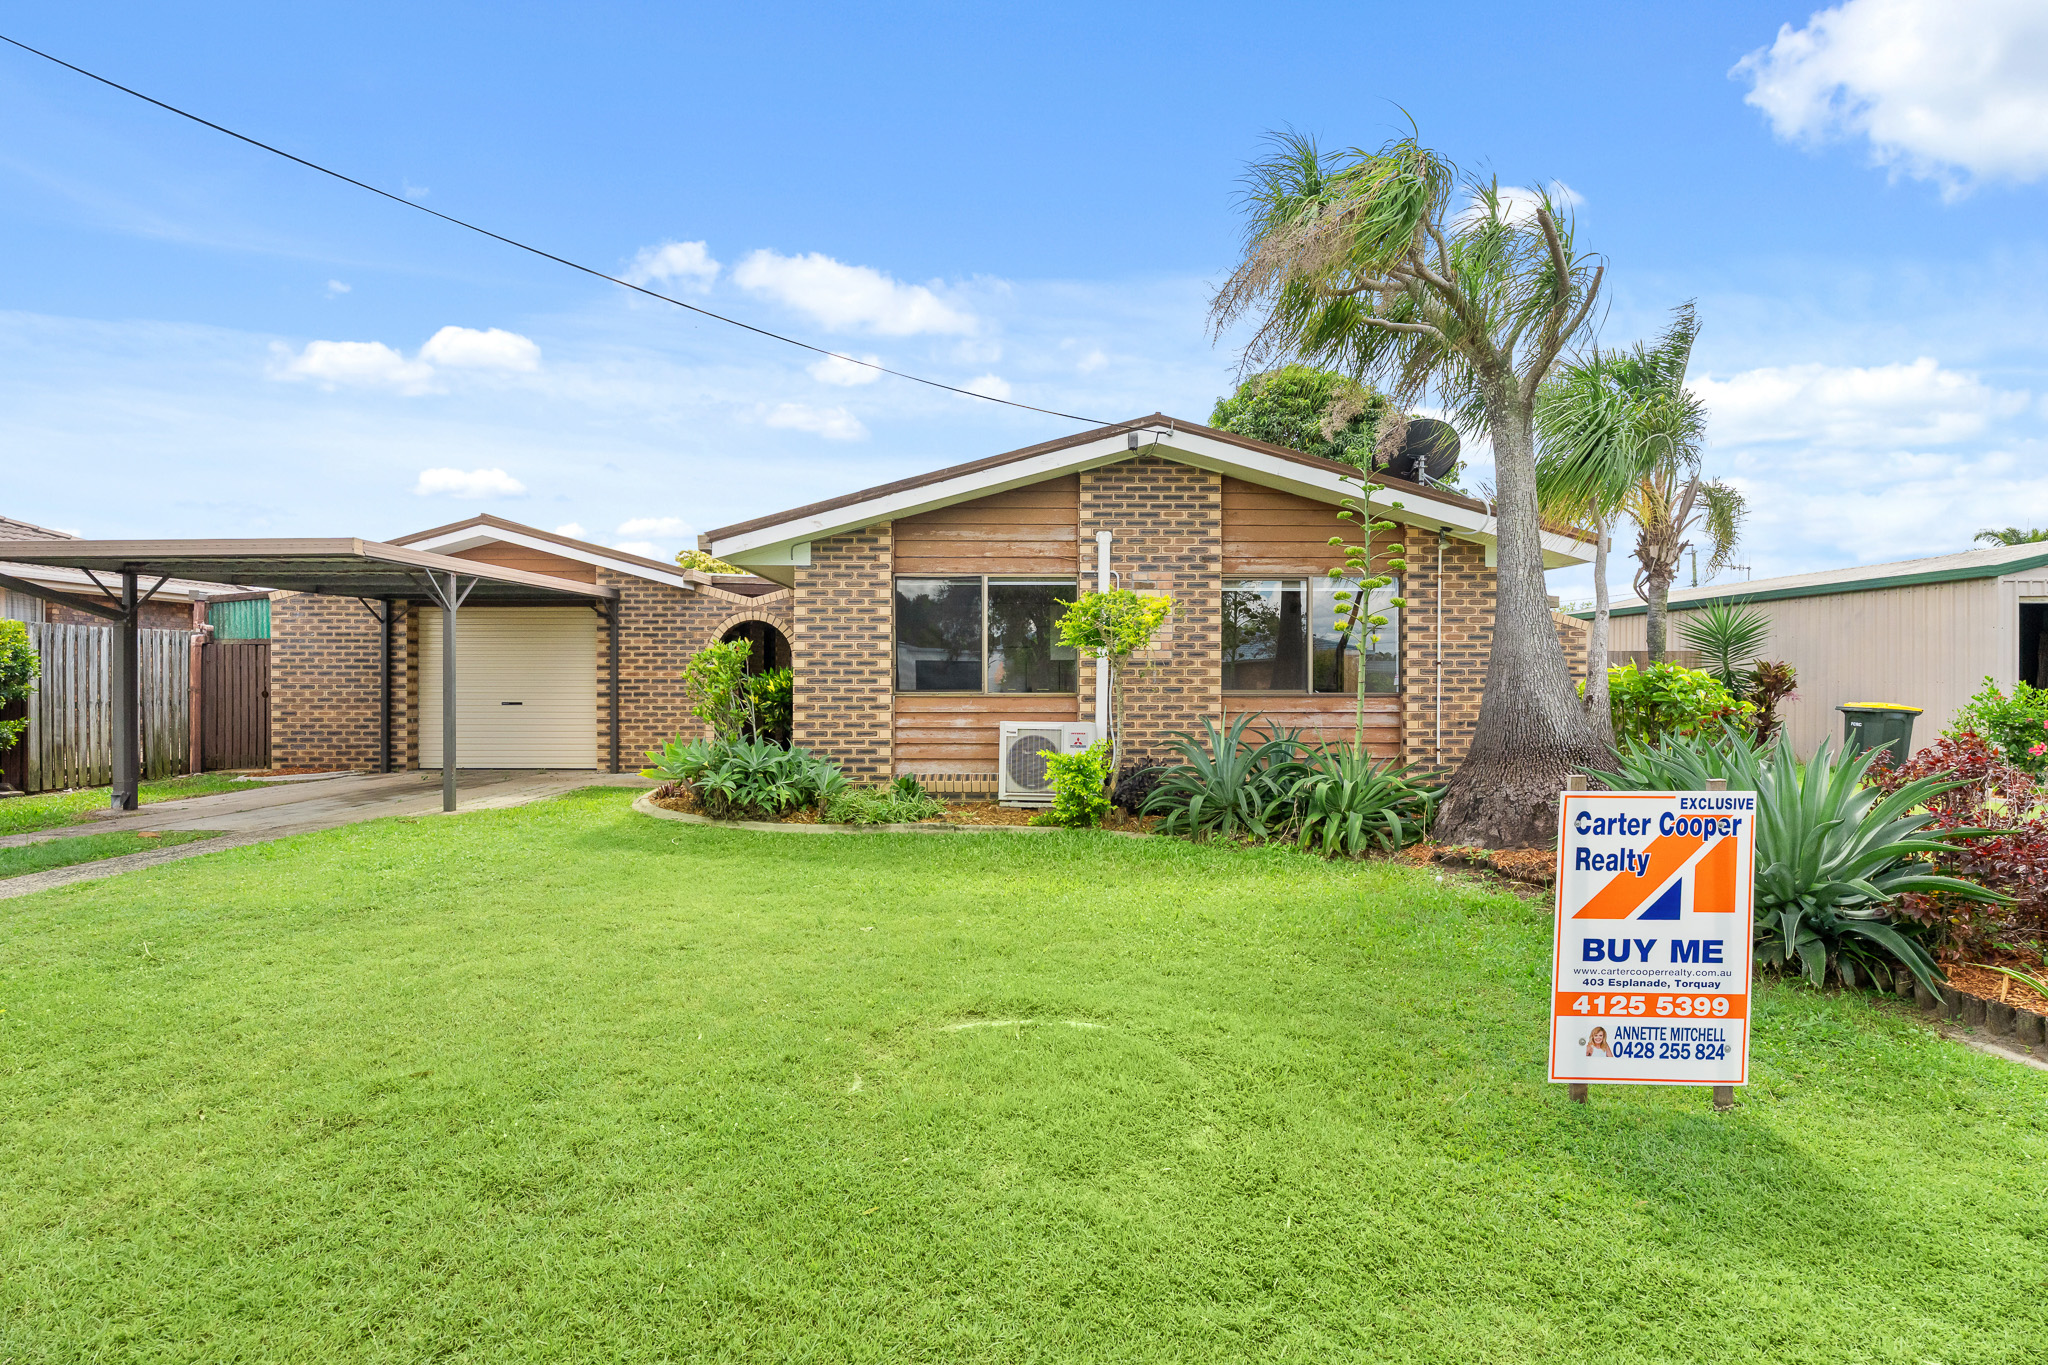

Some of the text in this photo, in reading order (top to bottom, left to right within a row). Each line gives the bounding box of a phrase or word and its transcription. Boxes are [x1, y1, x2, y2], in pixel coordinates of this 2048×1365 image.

[1680, 798, 1754, 810] EXCLUSIVE
[1575, 811, 1742, 841] Carter Cooper
[1575, 847, 1650, 876] Realty
[1582, 938, 1724, 963] BUY ME
[1573, 967, 1732, 978] www.cartercooperrealty.com.au
[1582, 978, 1721, 990] 403 Esplanade, Torquay
[1572, 995, 1730, 1016] 4125 5399
[1614, 1026, 1726, 1042] ANNETTE MITCHELL
[1613, 1042, 1725, 1060] 0428 255 824
